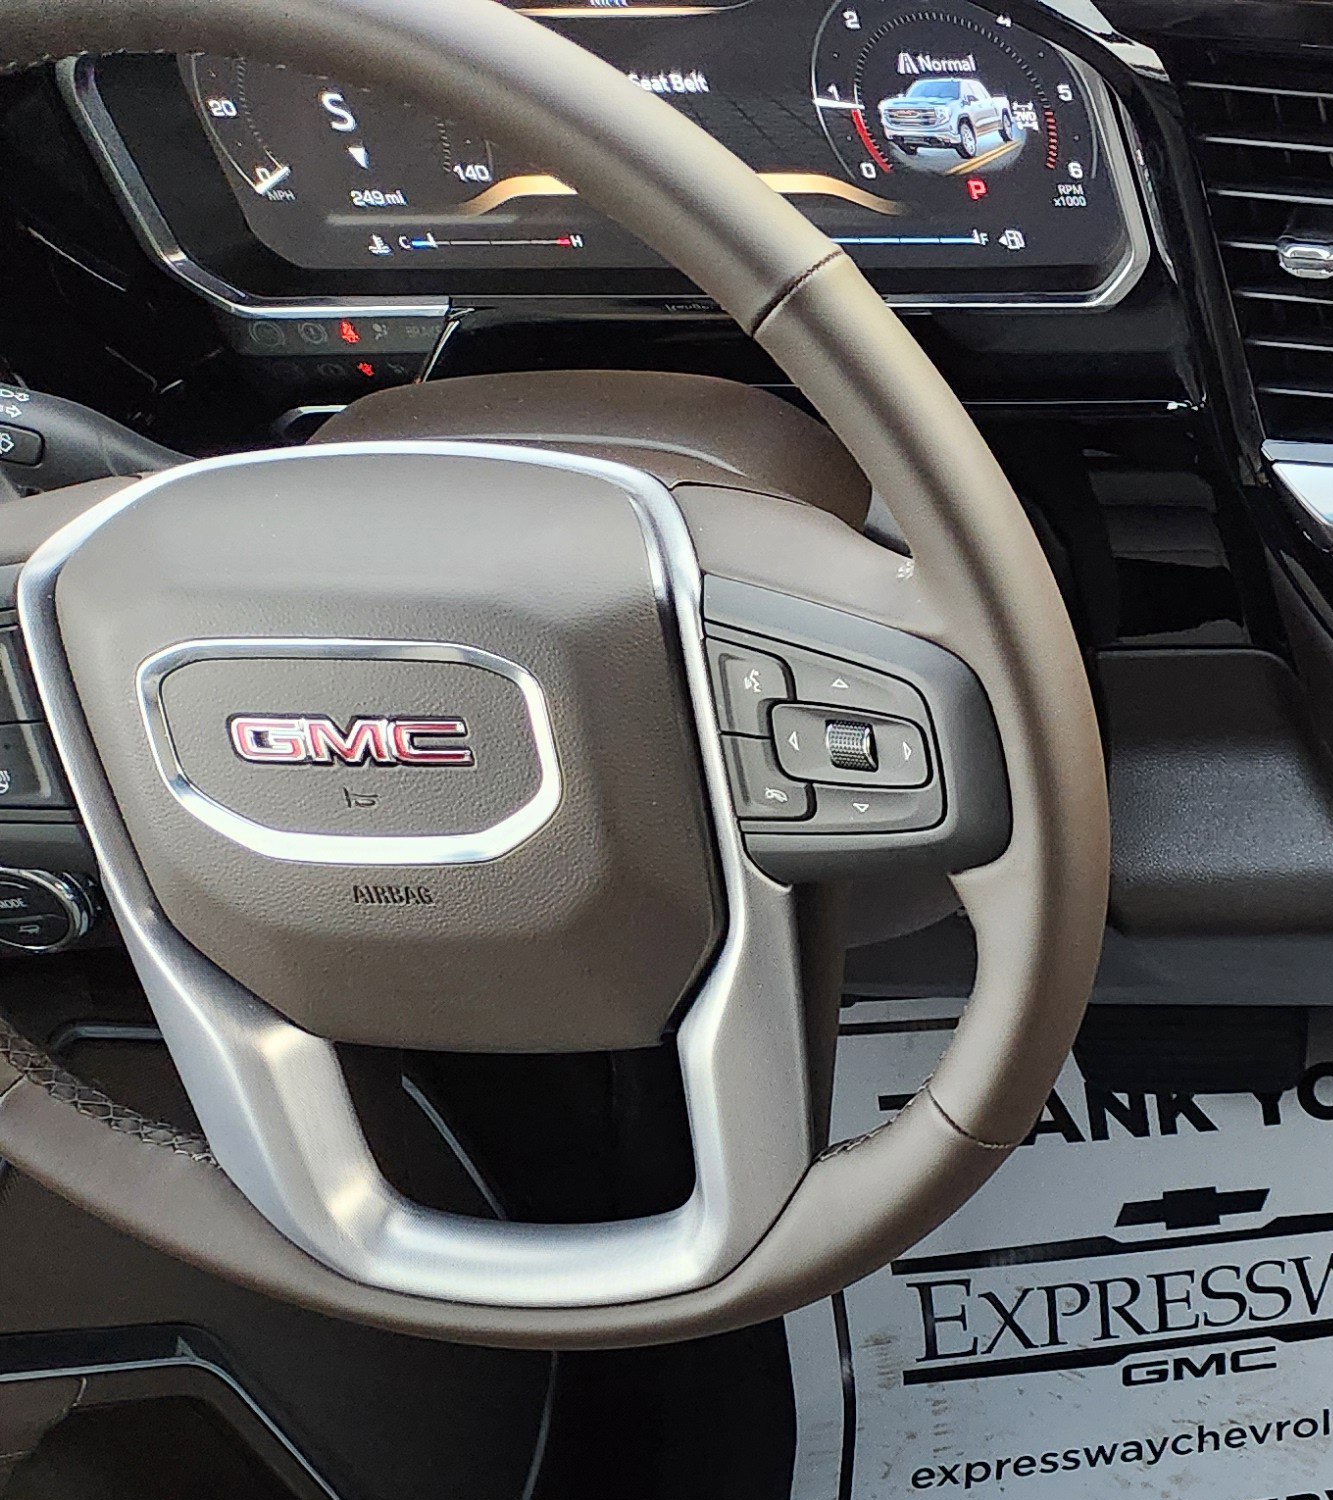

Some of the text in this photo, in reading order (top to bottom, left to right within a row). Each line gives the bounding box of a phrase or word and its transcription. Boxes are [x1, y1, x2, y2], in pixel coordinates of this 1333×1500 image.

[844, 11, 861, 30] 2
[919, 54, 976, 72] Normal
[669, 70, 711, 93] Belt
[1057, 84, 1073, 102] 5
[208, 99, 238, 117] 20
[321, 91, 357, 132] S
[453, 164, 490, 182] 140
[860, 162, 877, 179] 0
[1068, 162, 1084, 179] 6
[967, 179, 988, 200] P
[1058, 184, 1084, 196] RPM
[1054, 196, 1087, 207] x1000
[399, 235, 412, 250] C
[570, 234, 584, 249] H
[226, 712, 475, 767] GMC
[353, 885, 434, 905] AIRBAG
[1121, 1345, 1279, 1387] GMC
